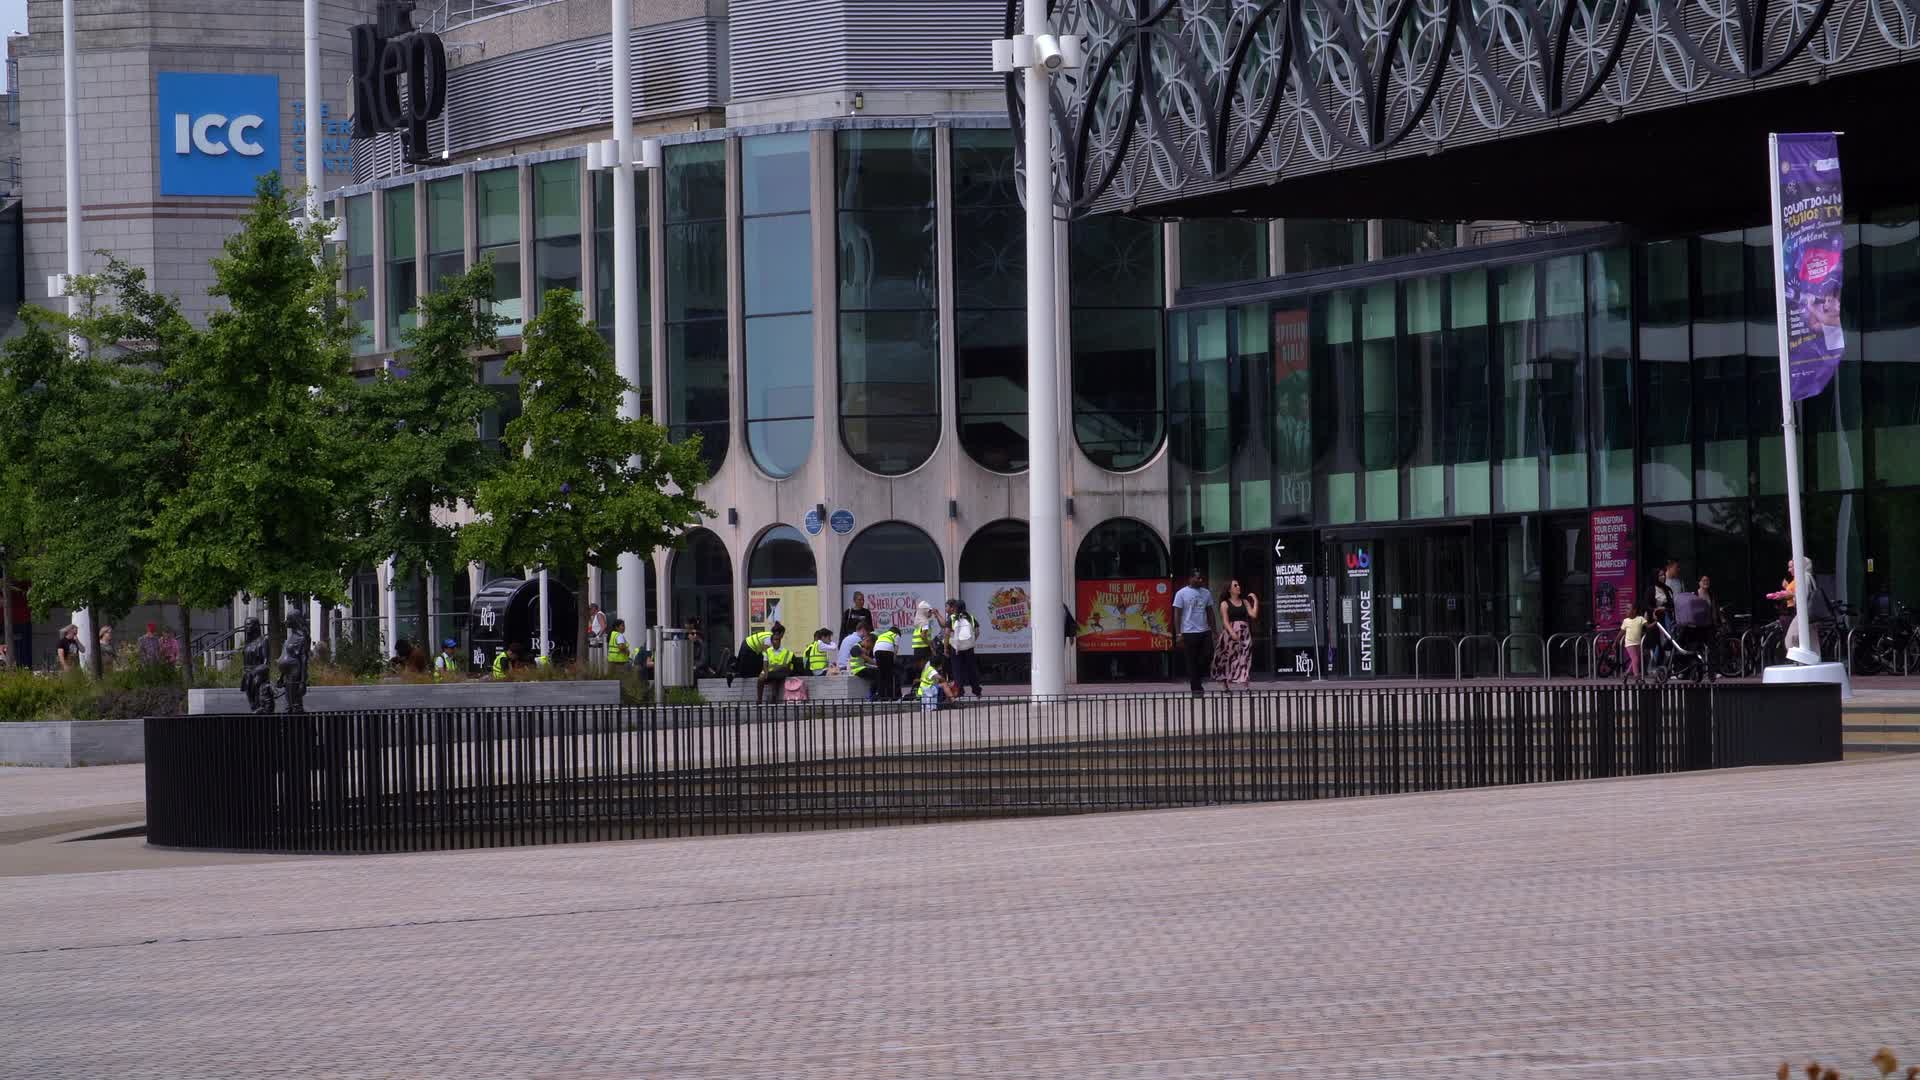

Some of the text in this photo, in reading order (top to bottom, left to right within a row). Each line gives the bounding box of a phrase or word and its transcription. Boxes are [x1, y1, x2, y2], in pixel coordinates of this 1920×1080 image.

[350, 24, 447, 164] Rep
[294, 102, 329, 118] TE
[175, 113, 265, 156] ICC
[1783, 193, 1841, 218] COUNTDOWN
[1281, 475, 1311, 513] Rep
[1594, 515, 1624, 525] TRANSFORM
[1594, 524, 1627, 534] YOUR EVENTS
[1594, 533, 1618, 543] FROM THE
[1594, 542, 1618, 551] MUNDANE
[1595, 551, 1612, 560] TO THE
[1276, 565, 1303, 575] WELCOME
[1595, 559, 1627, 569] MAGNIFICENT
[1277, 575, 1307, 586] TO THE REP
[1109, 583, 1136, 593] THE BOY
[1096, 589, 1150, 604] WITH WINGS
[480, 607, 496, 631] Rep
[1360, 590, 1372, 671] ENTRANCE
[530, 637, 556, 651] Rp
[1150, 637, 1173, 651] Rep
[473, 649, 486, 669] Rep
[1295, 654, 1314, 677] Rep
